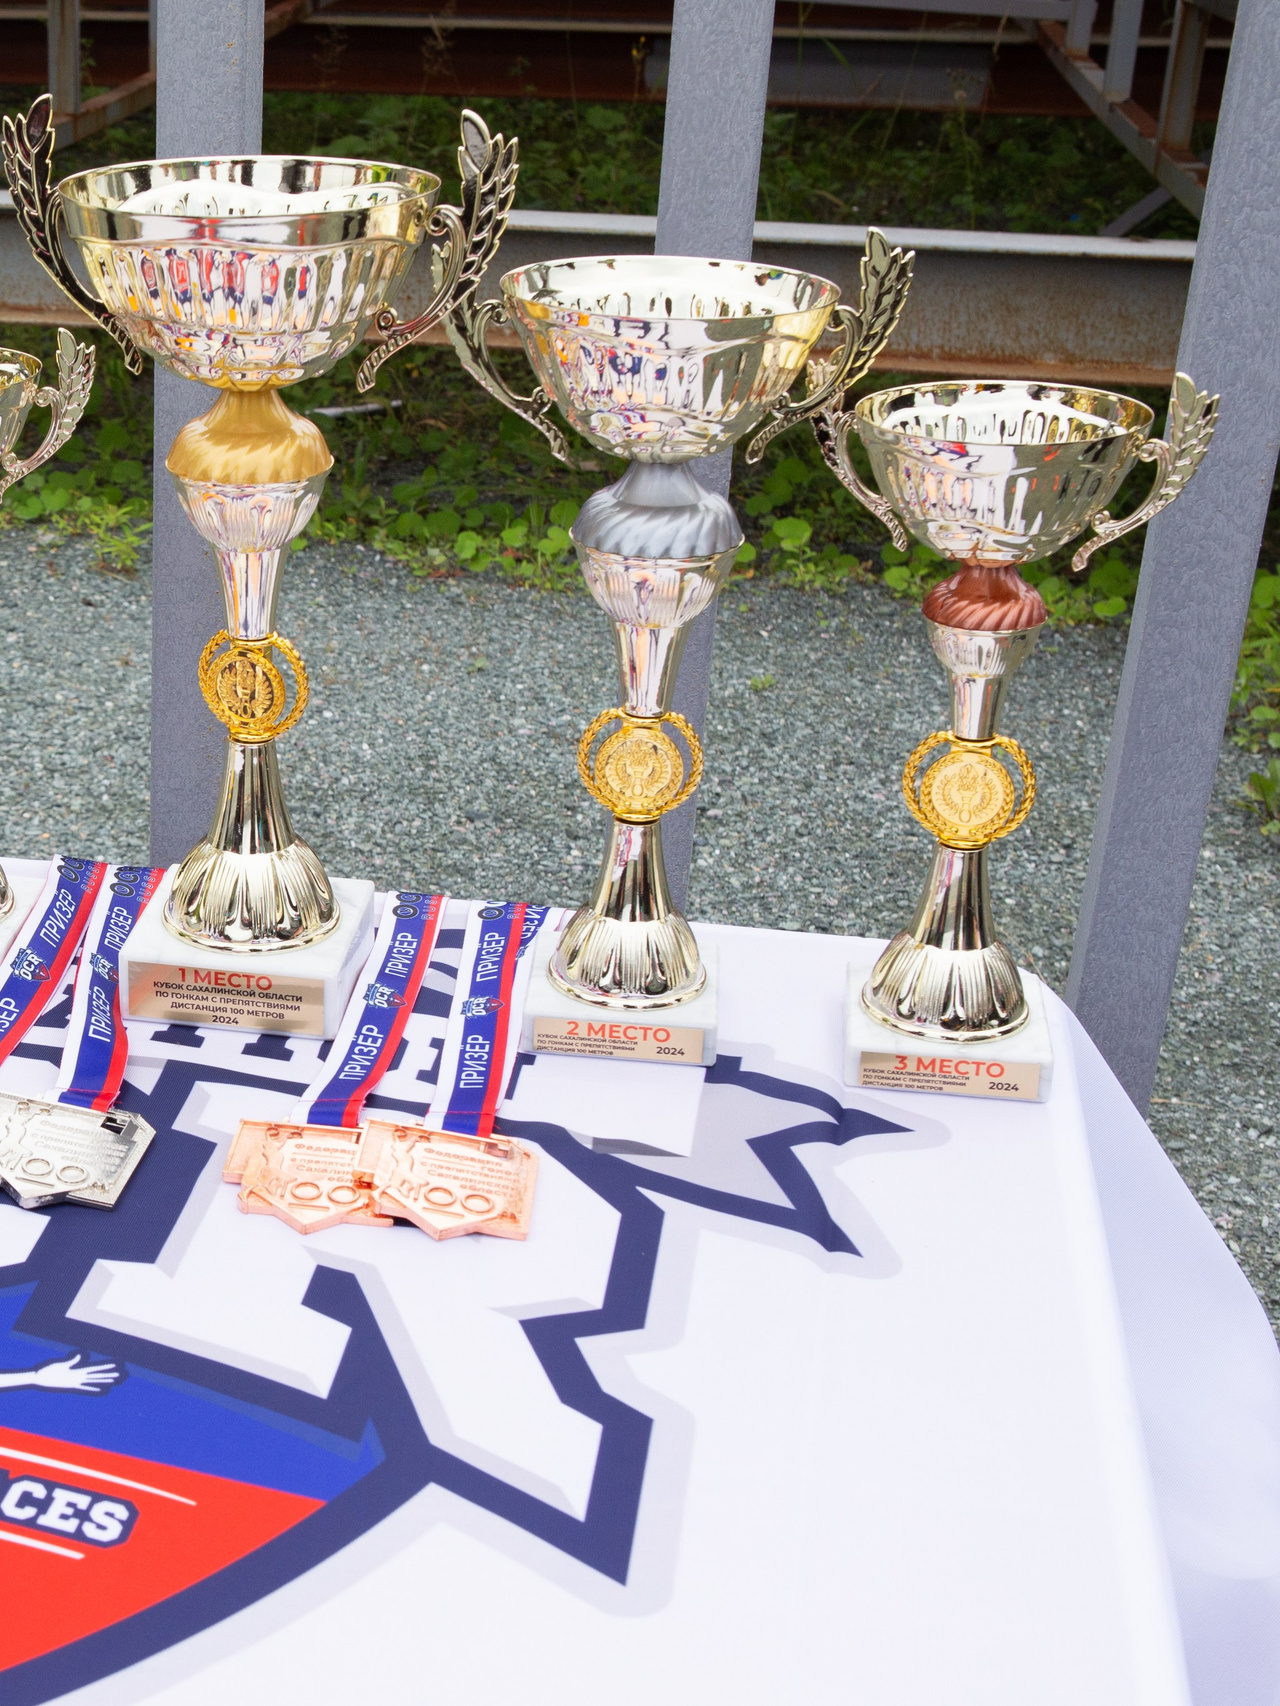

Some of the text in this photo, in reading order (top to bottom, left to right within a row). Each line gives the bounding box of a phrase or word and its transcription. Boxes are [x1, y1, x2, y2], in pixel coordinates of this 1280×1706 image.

[40, 888, 76, 948] ПРИЗЁР
[104, 906, 133, 952] ПРИЗЁР
[20, 953, 43, 980] OCR
[385, 932, 418, 979] ПРИЗЁР
[476, 932, 505, 982] ПРИЗЁР
[99, 958, 113, 979] OCR
[179, 968, 273, 991] 1 МЕСТО
[153, 981, 302, 1002] КУБОК САХАЛИНСКОЙ ОБЛАСТИ
[155, 990, 169, 998] ПО
[171, 992, 209, 1002] ГОНКАМ
[219, 997, 301, 1012] ПРЕПЯТСТВИЯМИ
[374, 984, 395, 1008] OCR
[88, 986, 112, 1043] ПРИЗЁР
[170, 1001, 285, 1019] ДИСТАНЦИЯ 100 МЕТРОВ
[472, 996, 489, 1016] OCR
[212, 1015, 240, 1025] 2024
[566, 1020, 671, 1043] 2 МЕСТО
[338, 1024, 384, 1081] ПРИЗЁР
[459, 1034, 490, 1089] ПРИЗЁР
[656, 1046, 685, 1056] 2024
[894, 1055, 1005, 1078] 3 МЕСТО
[988, 1081, 1019, 1092] 2024
